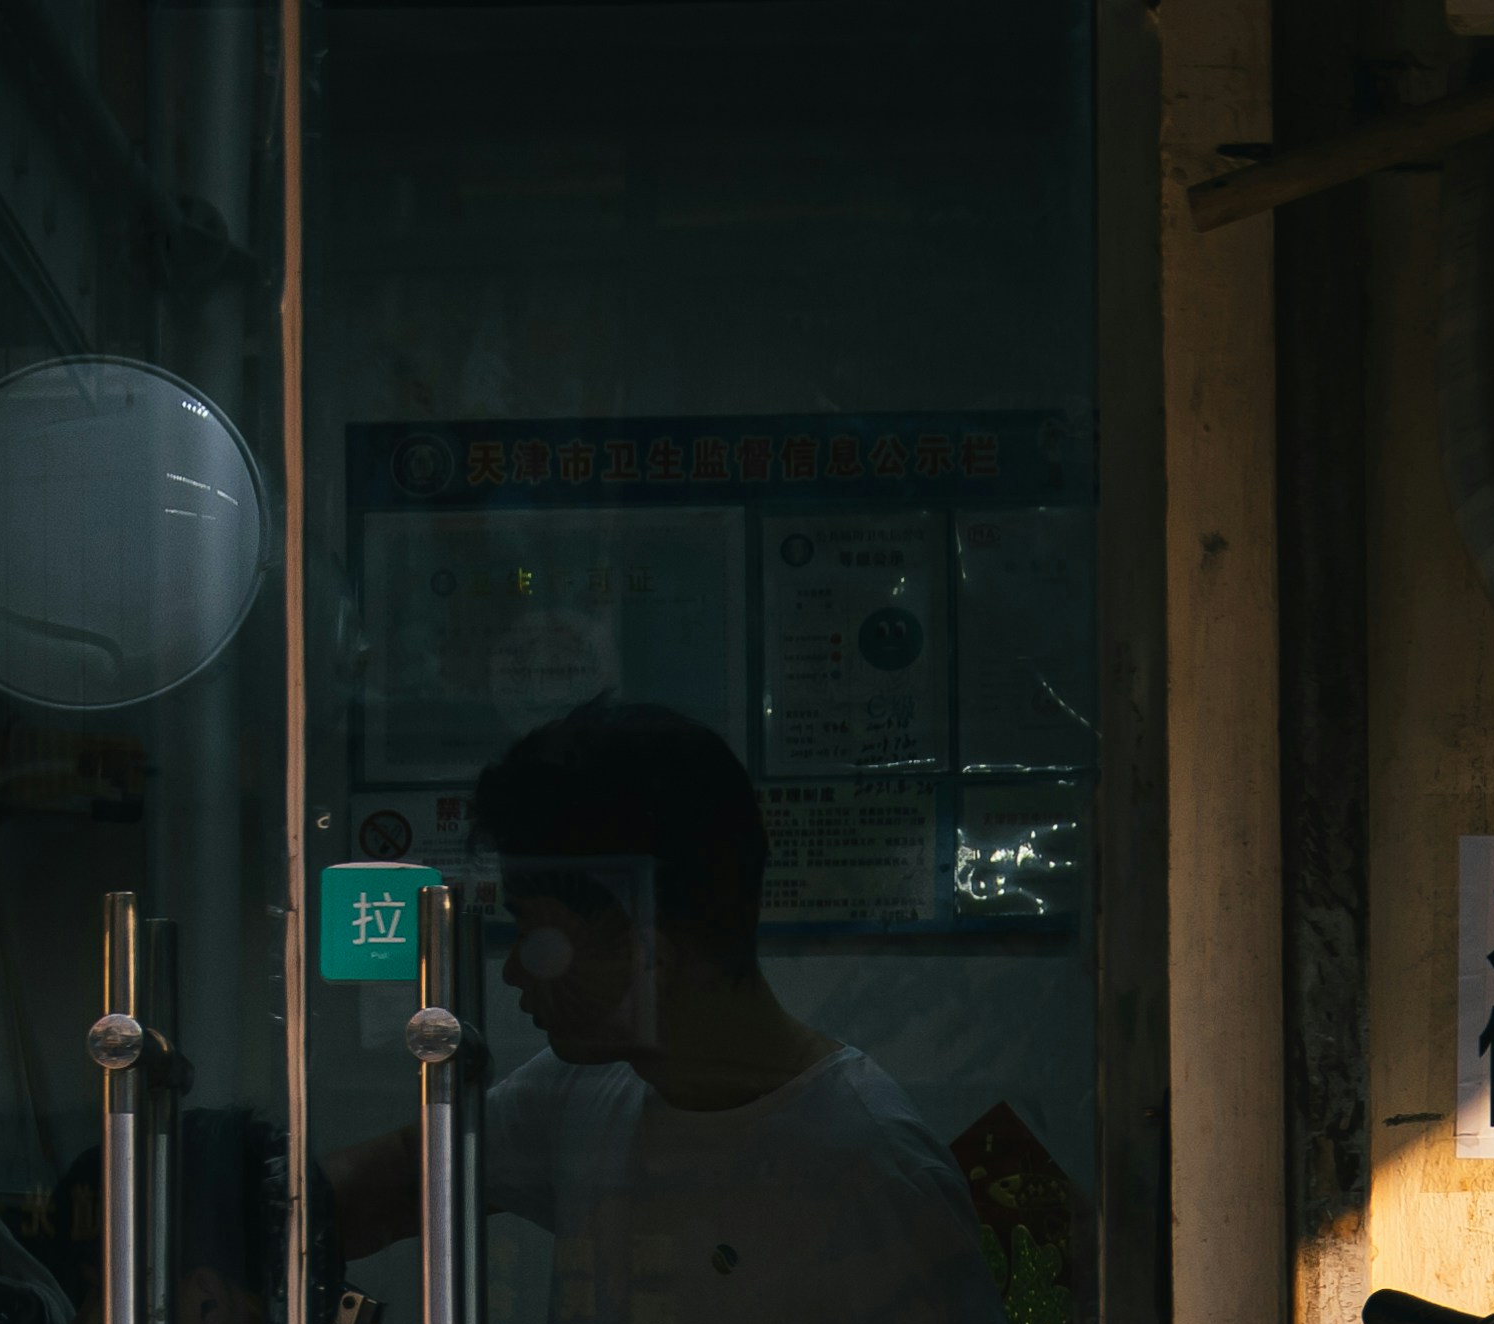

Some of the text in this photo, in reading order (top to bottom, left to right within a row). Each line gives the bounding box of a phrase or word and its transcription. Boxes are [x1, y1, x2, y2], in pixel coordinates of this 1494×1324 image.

[465, 434, 1002, 487] 天津市卫生监督信息公示栏
[351, 890, 407, 946] 拉
